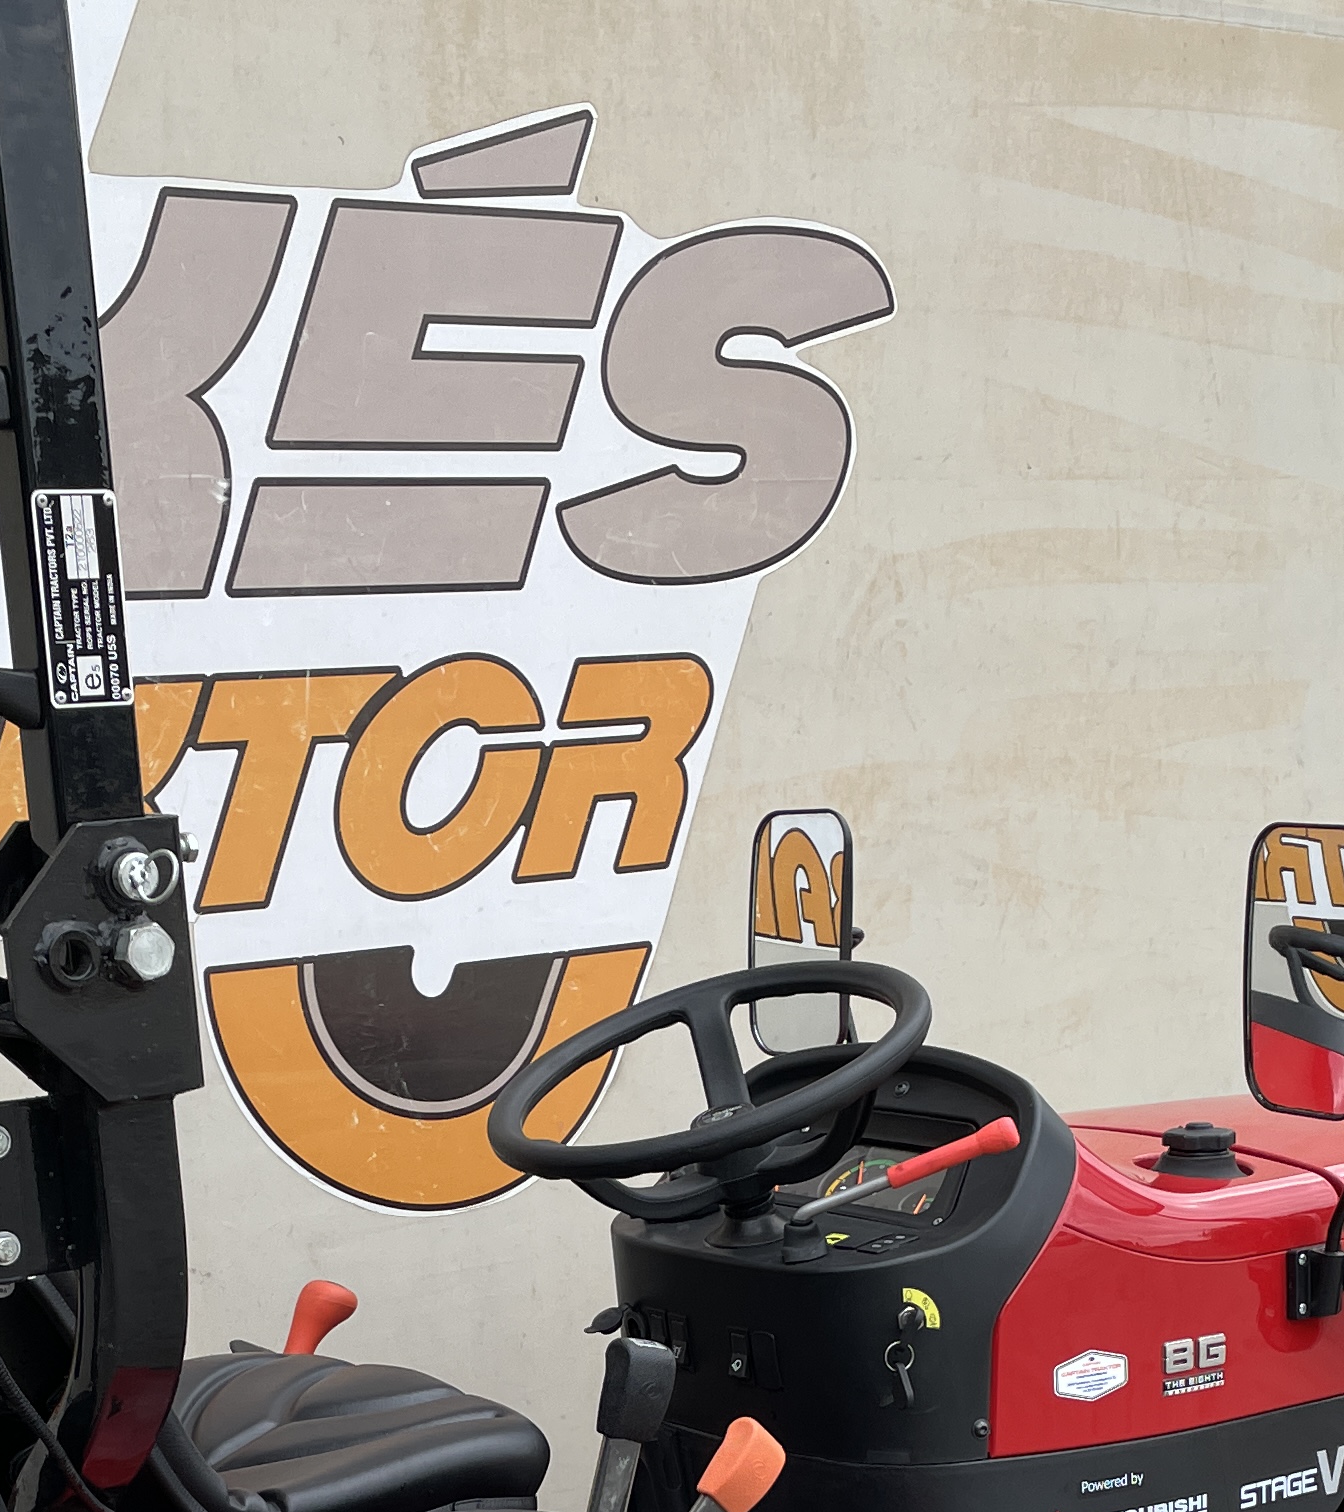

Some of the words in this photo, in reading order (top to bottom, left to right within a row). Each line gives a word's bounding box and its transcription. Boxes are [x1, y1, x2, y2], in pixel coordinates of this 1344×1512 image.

[48, 549, 61, 598] TRACTORS
[72, 588, 80, 608] TYPE
[83, 596, 92, 625] SERIAL
[93, 580, 102, 607] MODEL
[53, 601, 65, 639] CAPTAIN
[74, 611, 84, 649] TRACTOR
[95, 610, 105, 649] TRACTOR
[68, 643, 80, 701] CAPTAIN
[110, 664, 122, 699] 00070
[1165, 1380, 1186, 1390] THE
[1188, 1371, 1225, 1387] EIGHTH
[1081, 1473, 1128, 1494] Powered
[1130, 1471, 1144, 1488] by
[1240, 1468, 1318, 1509] STAGE
